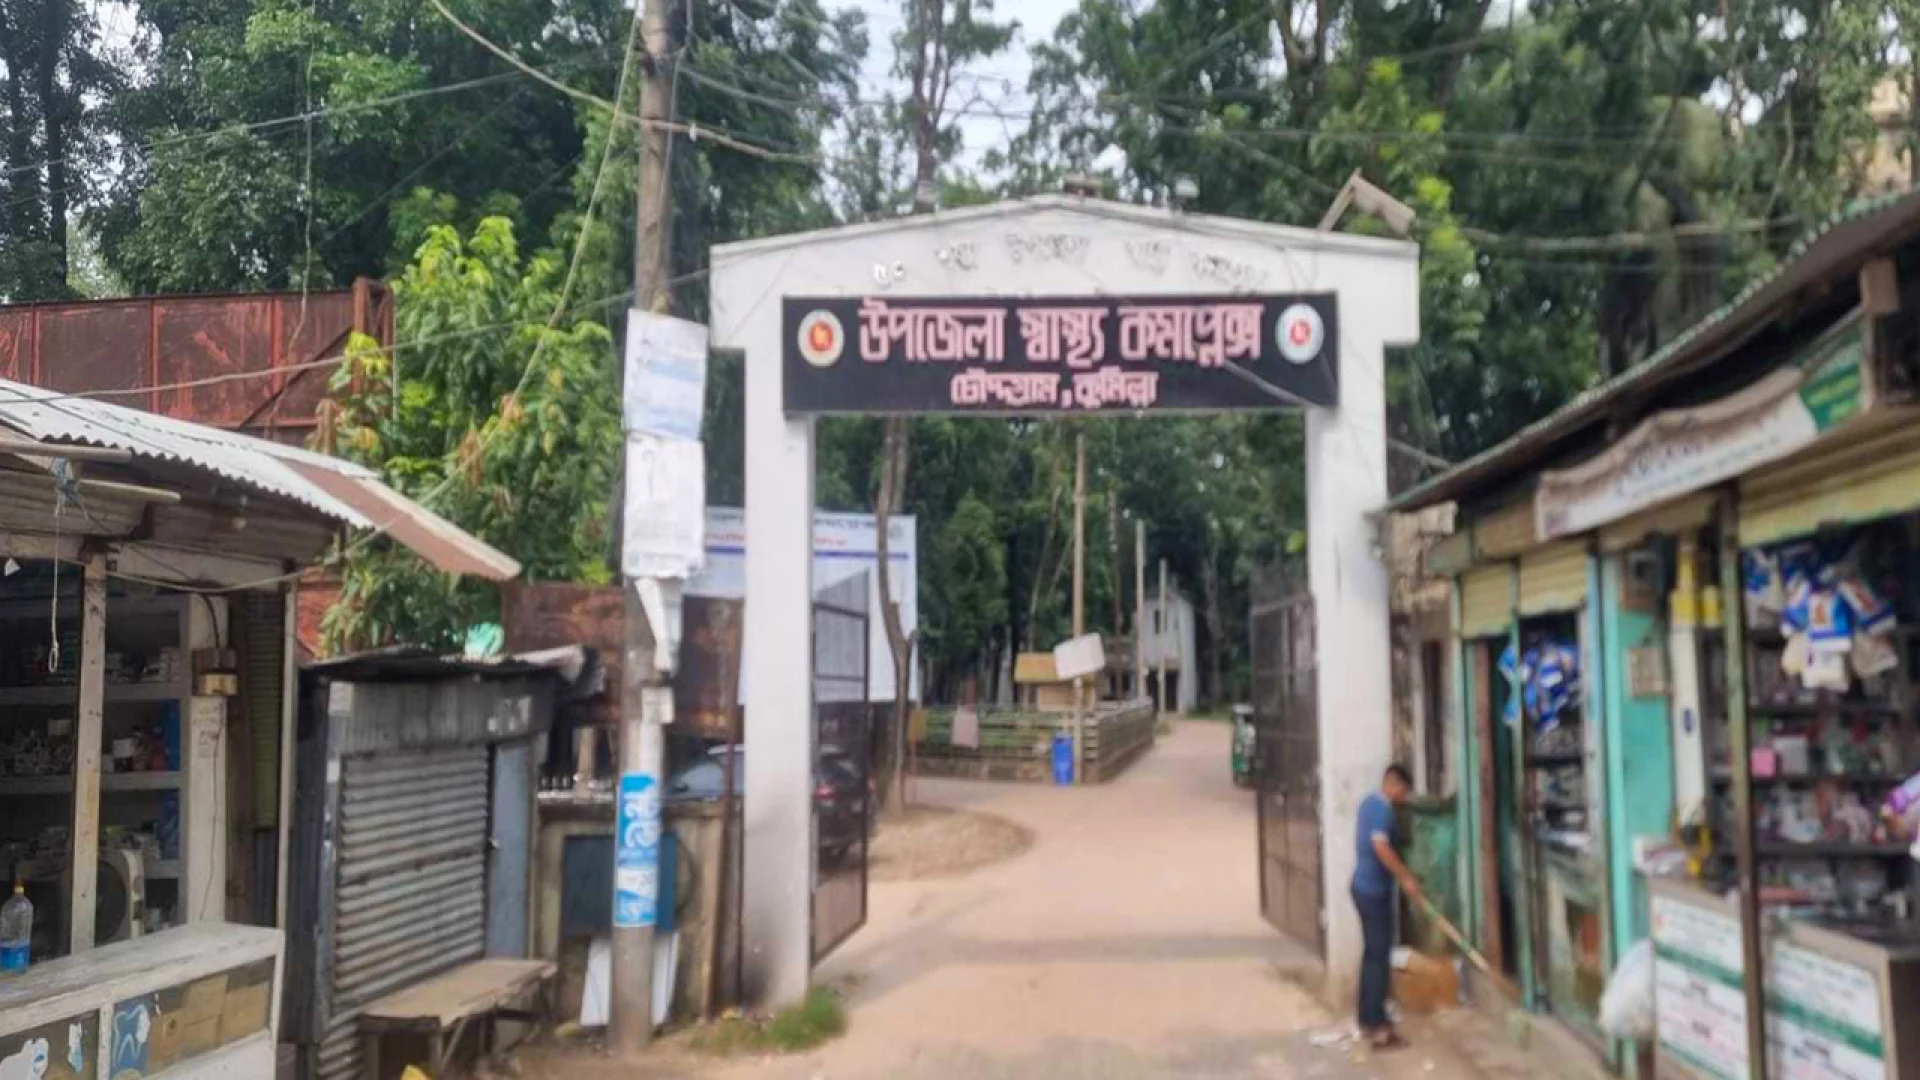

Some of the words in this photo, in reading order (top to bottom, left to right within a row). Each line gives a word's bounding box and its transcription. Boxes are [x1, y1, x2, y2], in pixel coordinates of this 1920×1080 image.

[858, 297, 1007, 362] উপজেলা
[1016, 308, 1109, 368] স্বাস্থ্য
[1117, 304, 1265, 368] কমপ্লেক্স
